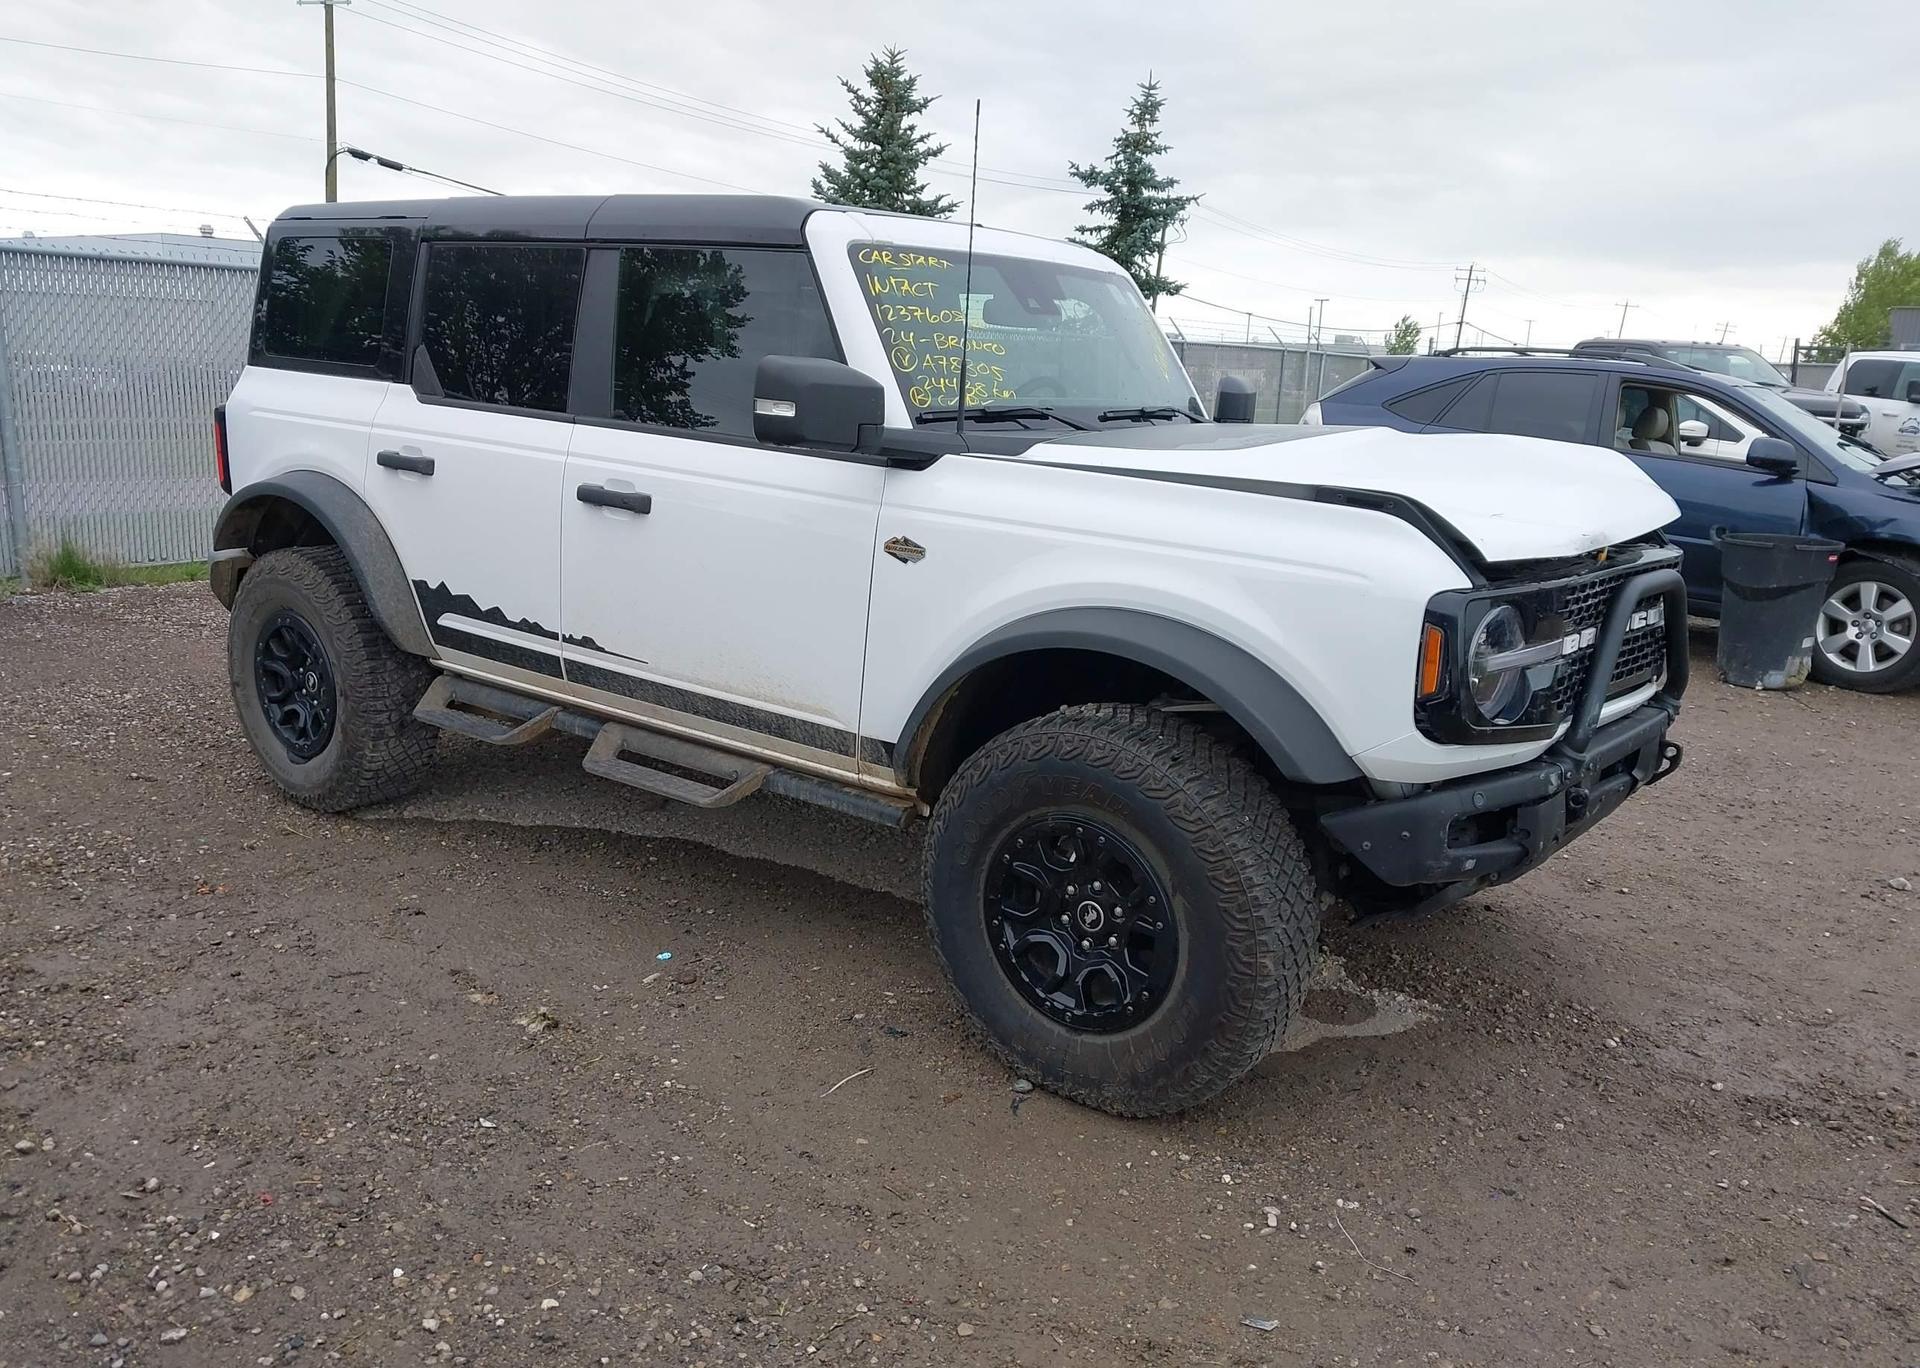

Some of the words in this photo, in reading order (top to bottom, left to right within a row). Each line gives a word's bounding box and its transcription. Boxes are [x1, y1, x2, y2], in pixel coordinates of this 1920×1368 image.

[858, 248, 898, 266] CAR
[899, 252, 954, 269] START
[866, 273, 940, 301] INTACT
[1562, 608, 1664, 655] BRCO
